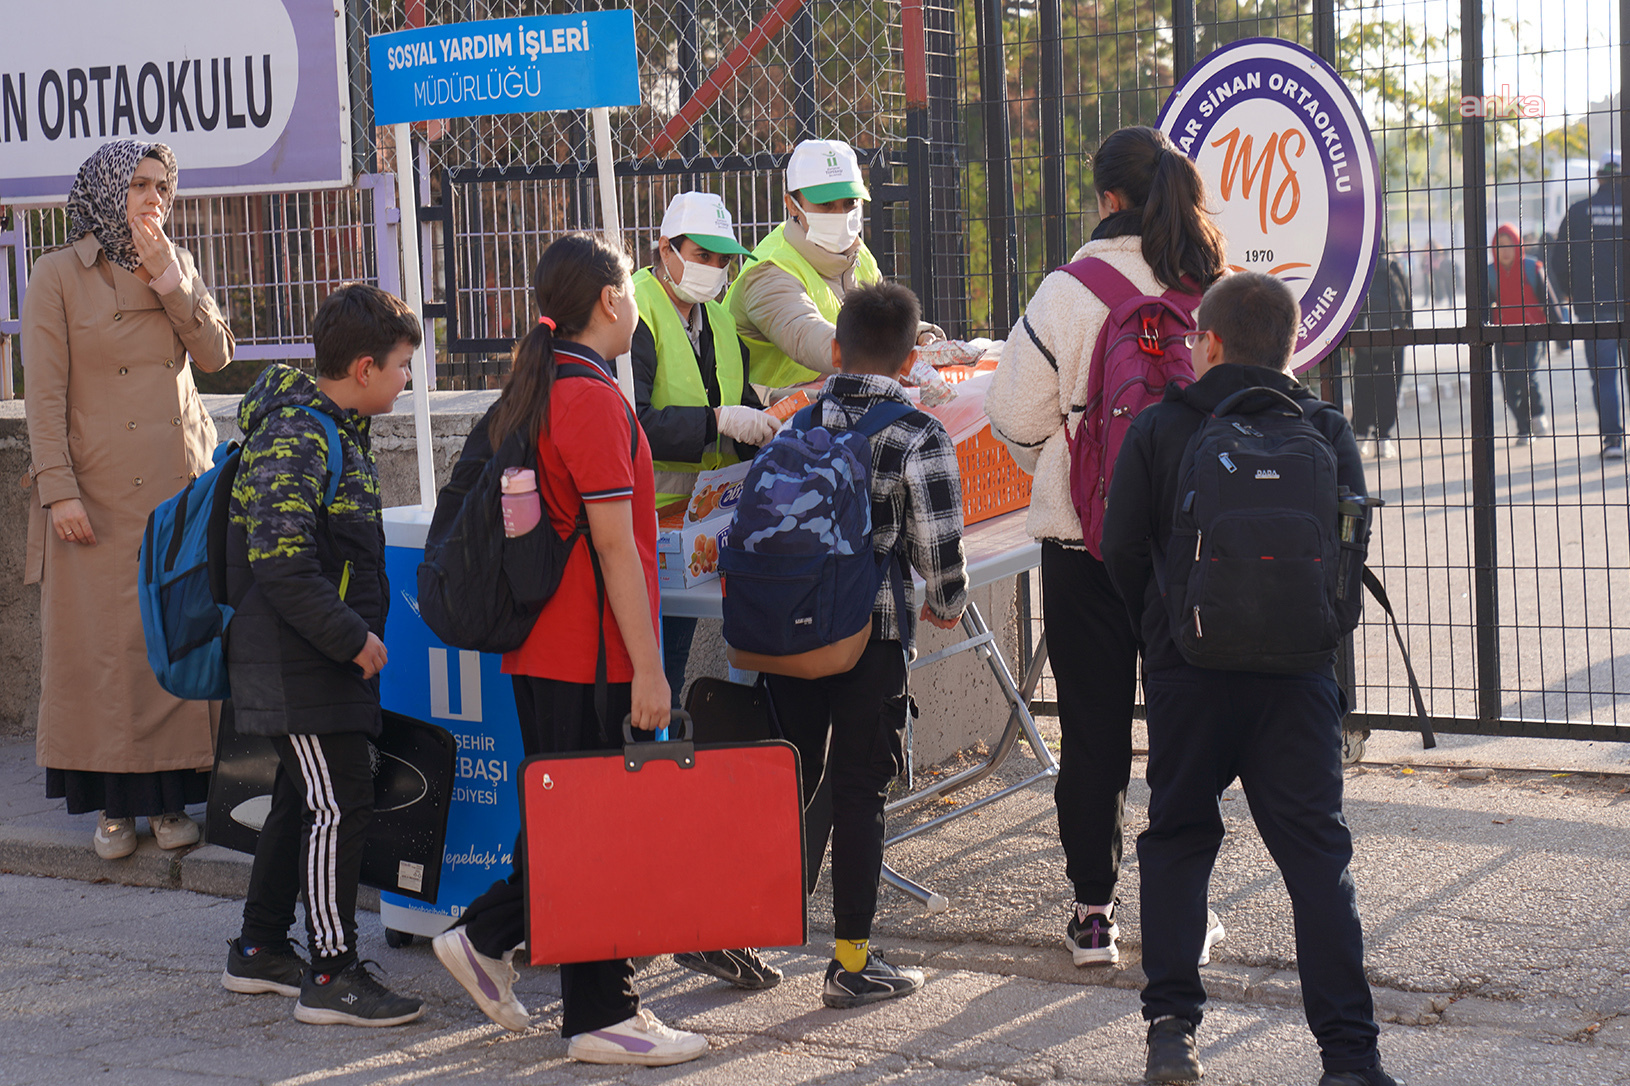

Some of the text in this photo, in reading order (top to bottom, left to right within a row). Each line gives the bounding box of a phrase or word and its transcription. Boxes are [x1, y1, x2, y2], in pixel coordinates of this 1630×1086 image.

[387, 19, 590, 71] SOSYAL YARDIM İŞLERİ
[0, 54, 273, 143] N ORTAOKULU
[414, 65, 542, 107] MÜDÜRLÜĞÜ
[1176, 71, 1352, 193] AR SİNAN ORTAOKULU
[1245, 249, 1274, 263] 1970
[450, 730, 496, 752] ŞEHİR
